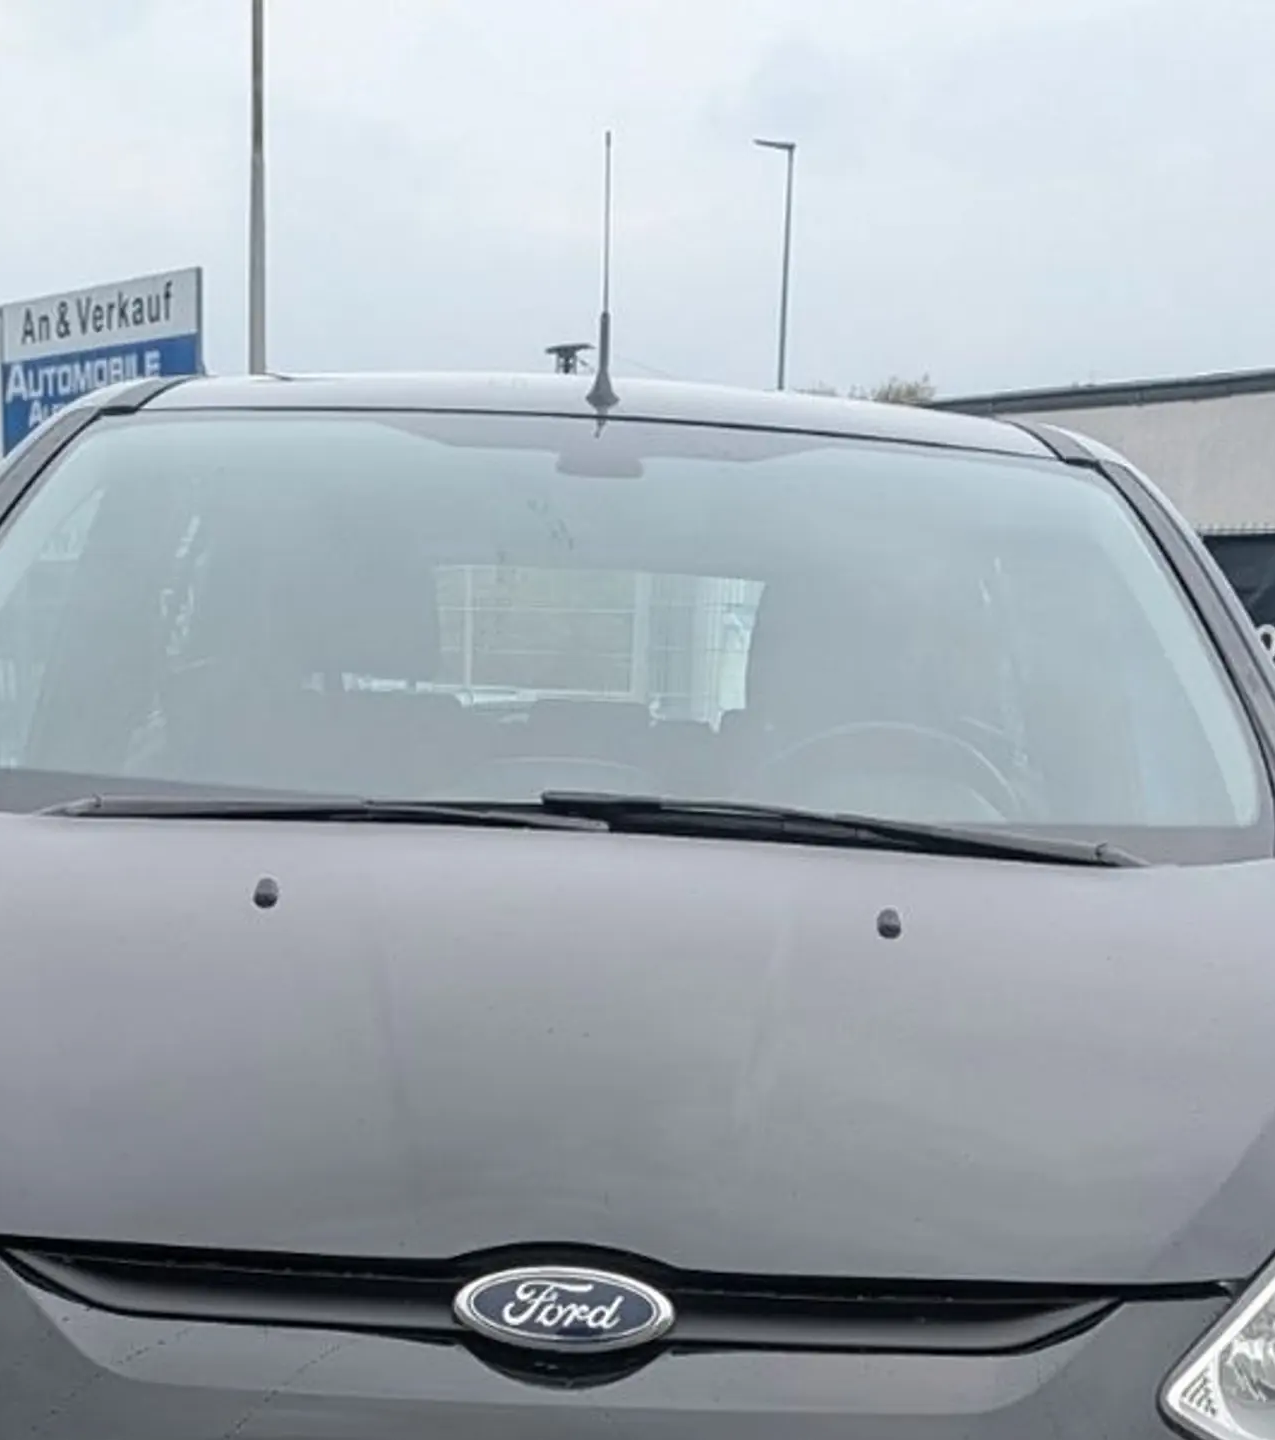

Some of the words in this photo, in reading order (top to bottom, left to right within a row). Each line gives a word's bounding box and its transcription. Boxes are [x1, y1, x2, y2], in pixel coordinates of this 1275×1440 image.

[21, 306, 51, 346] An
[56, 300, 71, 339] &
[76, 280, 173, 336] Verkauf
[502, 1279, 625, 1330] Ford
